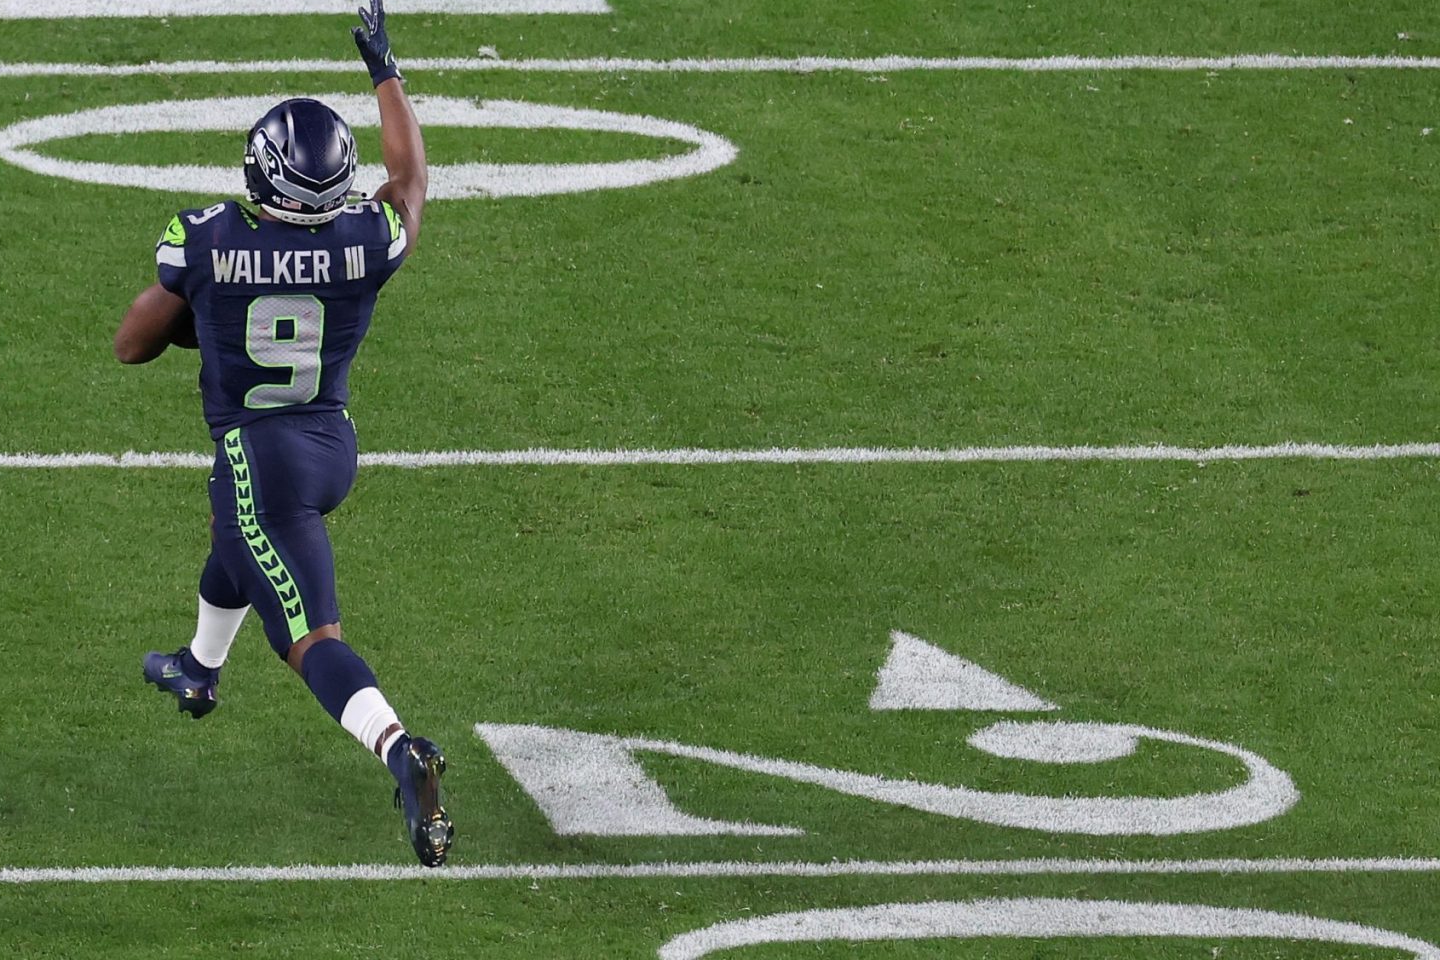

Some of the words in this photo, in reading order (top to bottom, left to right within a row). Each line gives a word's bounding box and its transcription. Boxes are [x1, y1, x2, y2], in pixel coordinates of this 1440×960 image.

[187, 203, 226, 225] 9
[212, 249, 331, 284] WALKER
[344, 245, 366, 280] III
[244, 294, 325, 409] 9
